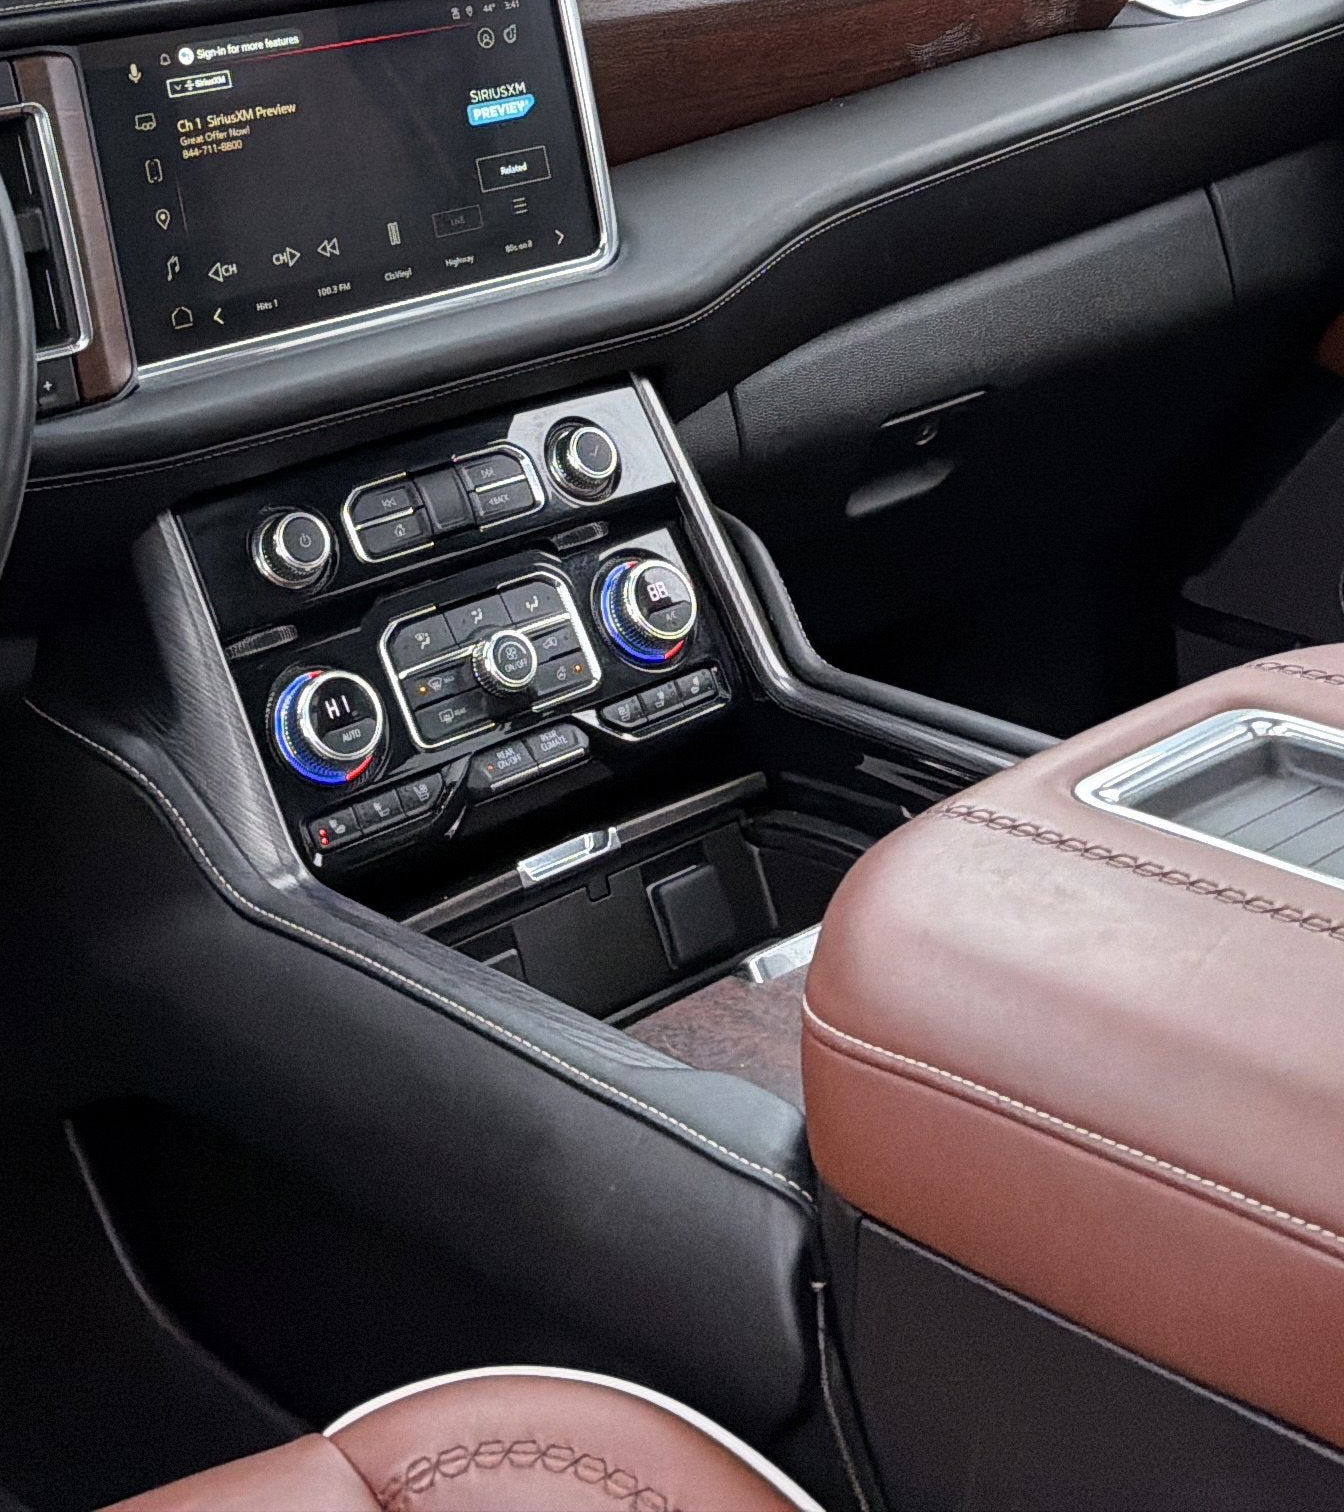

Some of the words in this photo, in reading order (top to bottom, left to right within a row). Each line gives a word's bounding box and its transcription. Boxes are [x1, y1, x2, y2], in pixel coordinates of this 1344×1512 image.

[196, 44, 227, 60] Sign-in
[227, 43, 240, 55] for
[241, 41, 264, 53] more
[264, 35, 300, 49] features
[469, 81, 527, 102] SIRIUSXM
[177, 119, 194, 133] Ch
[195, 117, 202, 129] 1
[207, 108, 254, 128] SiriusXM
[255, 103, 297, 119] Preview
[179, 133, 205, 147] Great
[499, 161, 528, 176] Related
[272, 252, 288, 266] CH
[222, 263, 238, 277] CH
[504, 657, 528, 673] ON/OFF
[324, 694, 351, 720] HI
[342, 728, 362, 743] AUTO
[496, 747, 515, 760] REAR
[497, 752, 522, 770] ON/OFF
